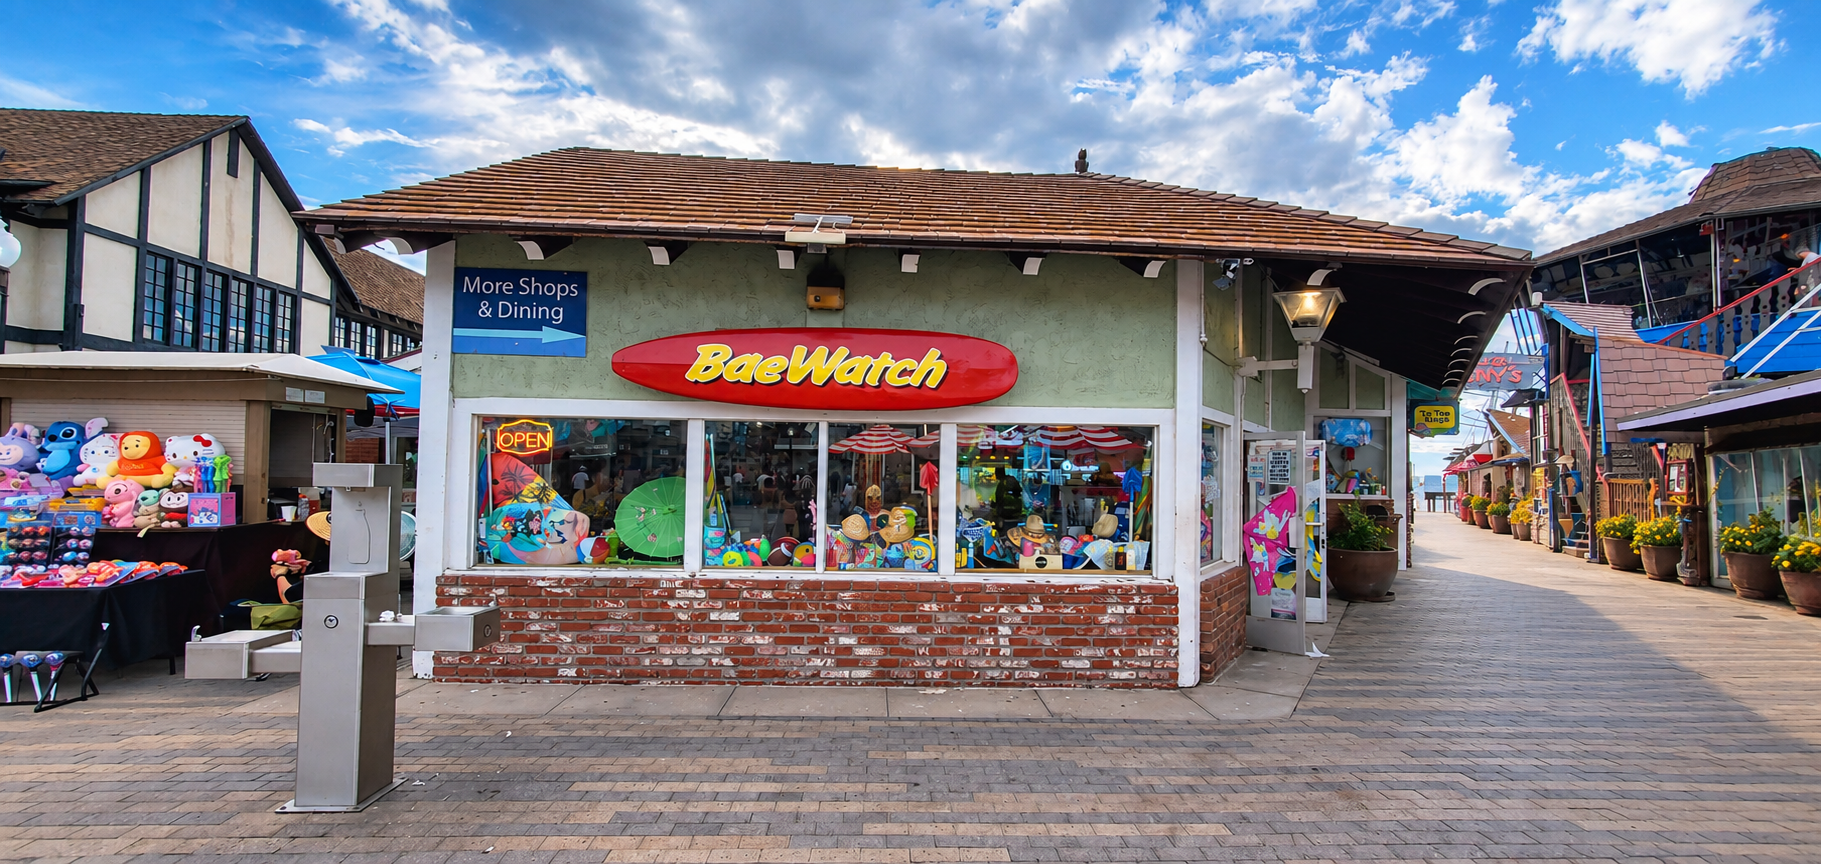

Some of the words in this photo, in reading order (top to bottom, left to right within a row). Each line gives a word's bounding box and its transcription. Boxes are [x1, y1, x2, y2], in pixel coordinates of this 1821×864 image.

[463, 276, 514, 295] More
[519, 276, 579, 301] Shops
[478, 300, 493, 318] &
[498, 301, 564, 324] Dining
[685, 344, 948, 388] BaeWatch
[500, 432, 550, 449] OPEN
